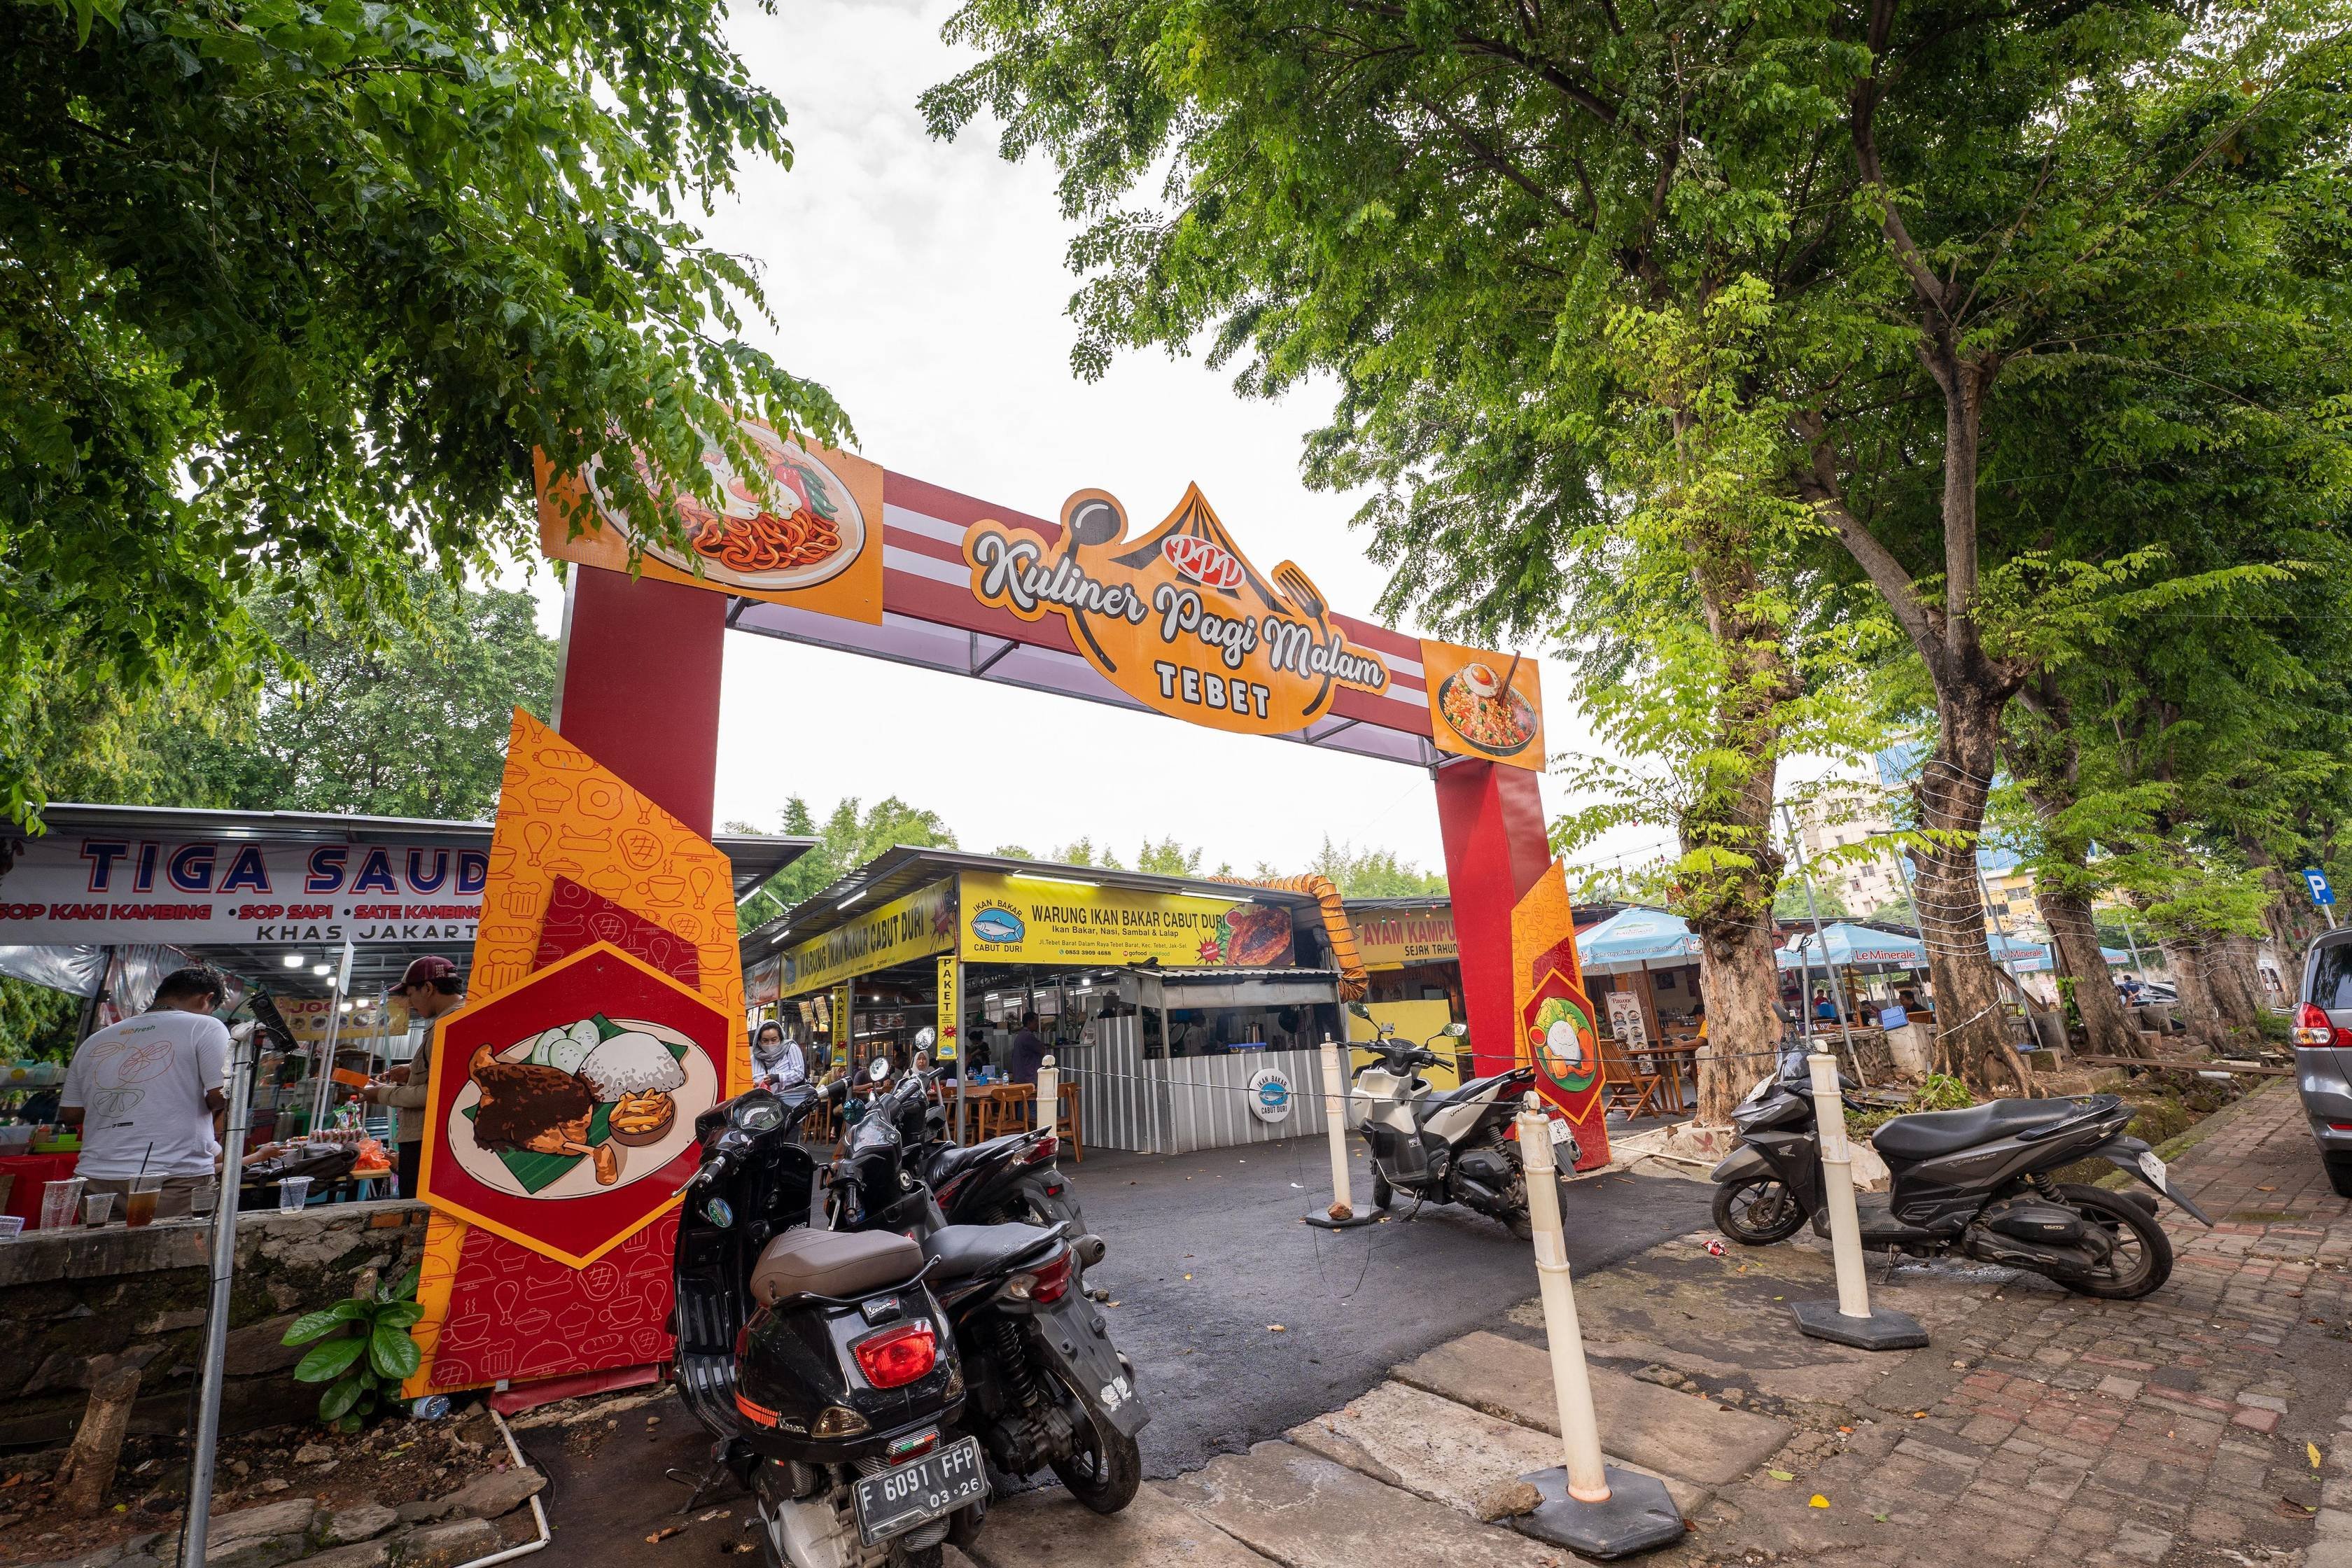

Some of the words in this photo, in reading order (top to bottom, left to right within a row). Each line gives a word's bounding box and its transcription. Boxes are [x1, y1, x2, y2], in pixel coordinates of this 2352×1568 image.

[976, 533, 1147, 620] Kuliner
[1156, 587, 1256, 665] Pagi
[1264, 620, 1385, 687] Malam
[1157, 664, 1268, 716] TEBET
[80, 840, 273, 894] TIGA
[2308, 876, 2326, 899] P
[48, 904, 108, 920] KAKI
[109, 904, 213, 920] KAMBING
[238, 904, 284, 920] SOP
[286, 904, 334, 920] SAPI
[354, 905, 403, 920] SATE
[973, 899, 992, 913] IKAN
[997, 899, 1023, 918] BAKAR
[1032, 905, 1086, 924] WARUNG
[1091, 909, 1118, 925] IKAN
[1123, 910, 1160, 927] BAKAR
[1163, 911, 1198, 928] CABUT
[1202, 913, 1226, 929] DURI
[256, 925, 342, 941] KHAS
[800, 945, 826, 978] WARUNG
[870, 914, 898, 953] CABUT
[901, 904, 924, 942] DURI
[1072, 926, 1098, 935] Bakar,
[1159, 929, 1179, 937] Lalap
[1364, 923, 1404, 946] AYAM
[974, 944, 1000, 952] CABUT
[1405, 945, 1429, 956] SEJAK
[1433, 944, 1459, 954] TAHUN
[1856, 950, 1868, 960] Le
[1870, 950, 1916, 960] Minerale
[2010, 949, 2043, 958] Minerale
[943, 959, 952, 1011] PAKET
[1257, 1076, 1269, 1088] IKAN
[1271, 1075, 1287, 1088] BAKAR
[862, 1486, 873, 1512] F
[884, 1464, 929, 1502] 6091
[941, 1446, 974, 1478] FFP
